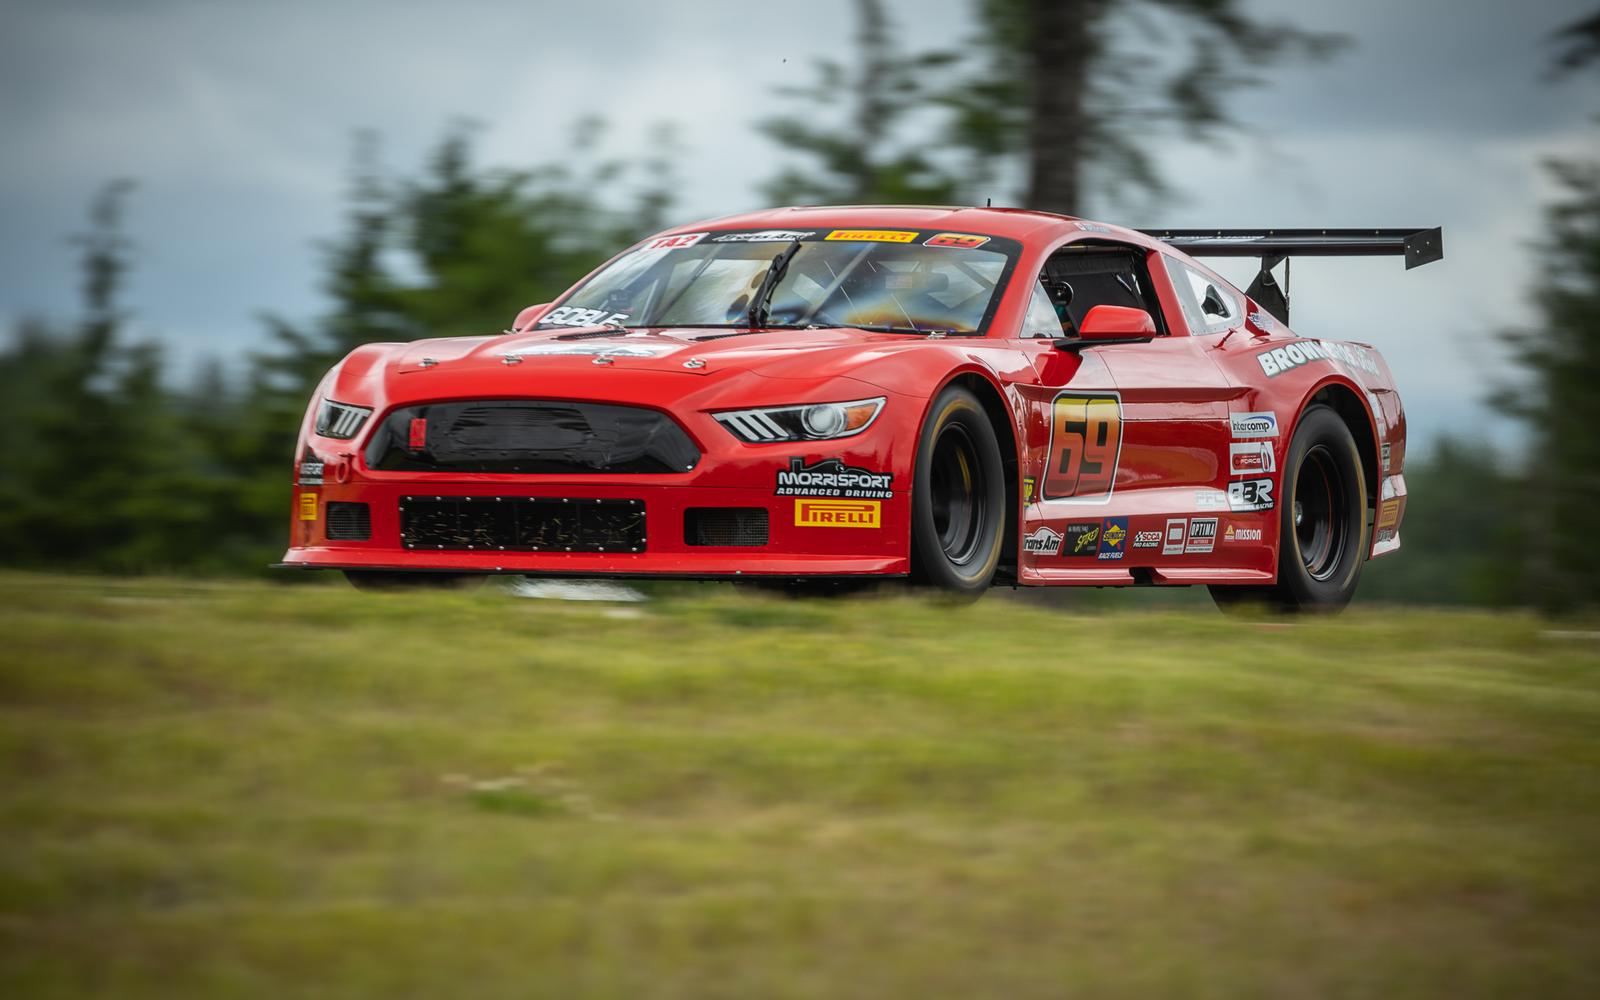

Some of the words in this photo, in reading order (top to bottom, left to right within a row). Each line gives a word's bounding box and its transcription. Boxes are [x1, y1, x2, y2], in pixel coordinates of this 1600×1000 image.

[833, 231, 911, 241] PIRELLI
[927, 234, 987, 249] 69
[1045, 397, 1121, 498] 69
[778, 472, 891, 488] MORRISPORT
[776, 487, 840, 496] ADVANCED
[845, 489, 893, 498] DRIVING
[801, 503, 875, 523] PIRELLI
[1191, 522, 1215, 537] OPTIMA
